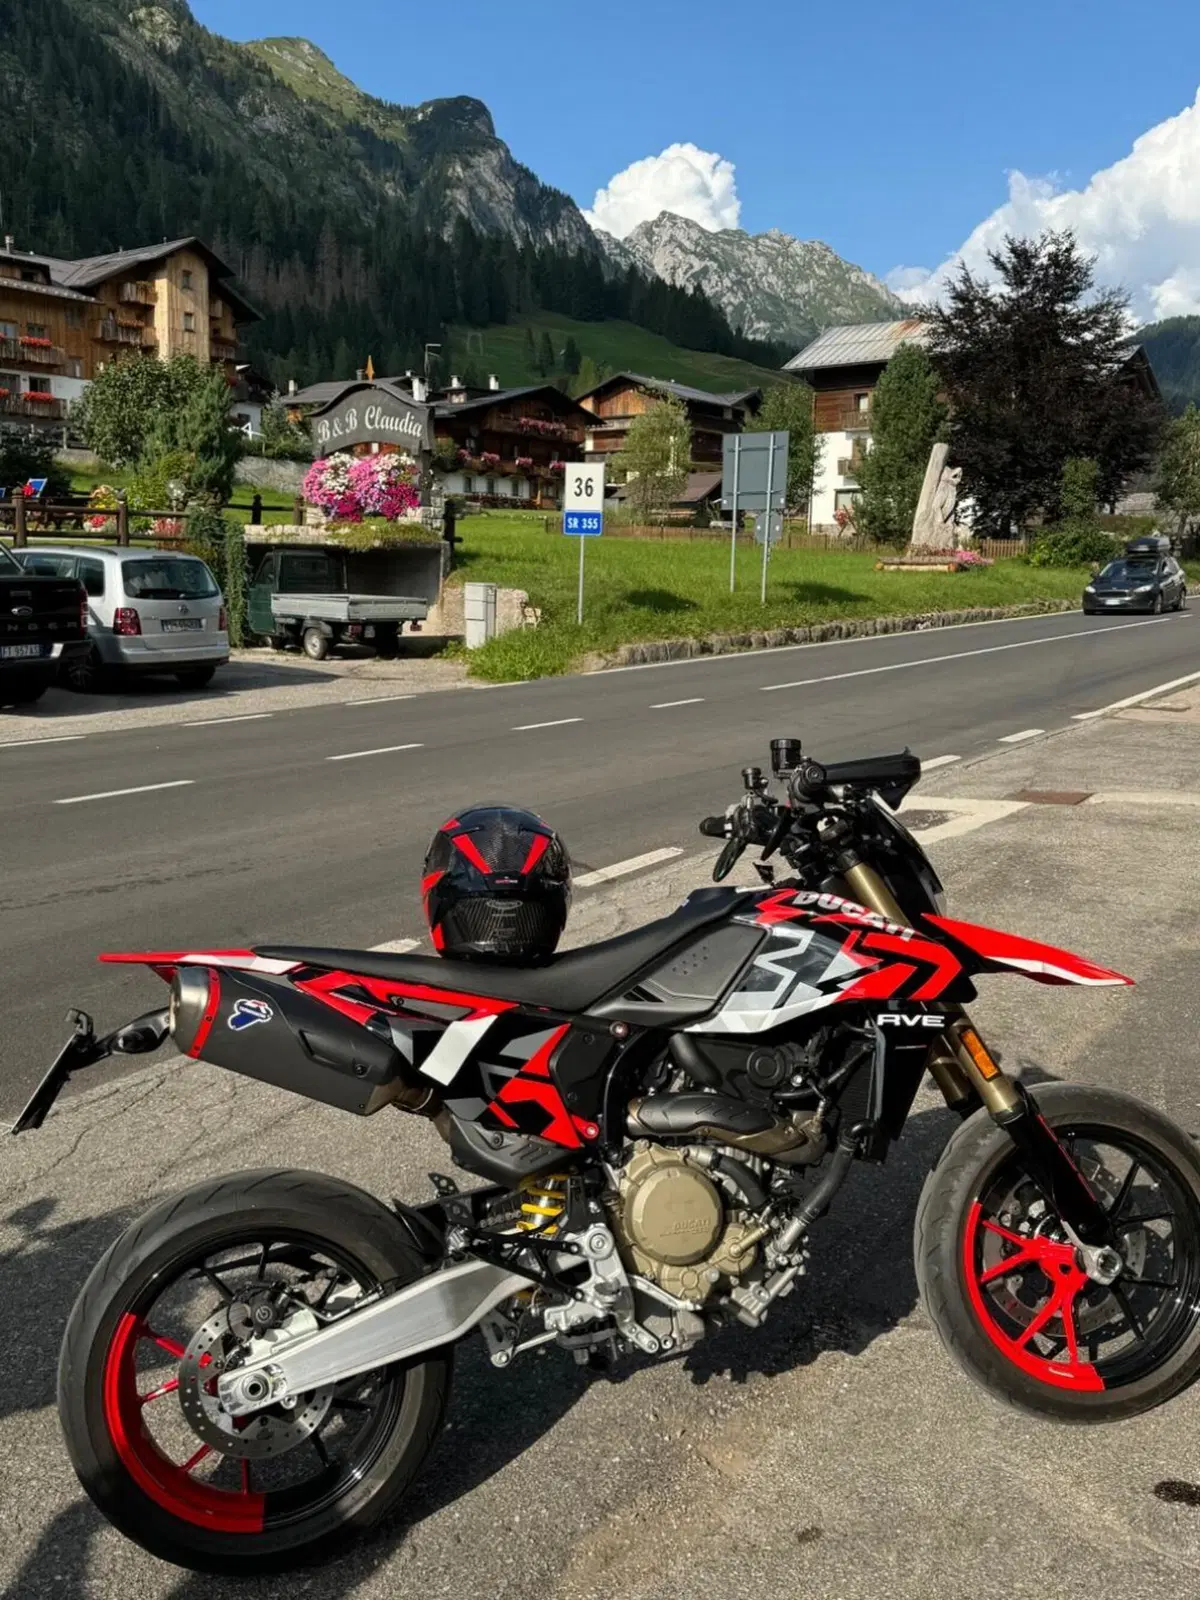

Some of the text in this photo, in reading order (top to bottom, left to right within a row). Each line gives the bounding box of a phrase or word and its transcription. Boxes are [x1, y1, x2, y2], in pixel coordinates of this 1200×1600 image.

[364, 405, 422, 437] Claudia
[574, 476, 594, 497] 36
[567, 517, 598, 530] SR 355
[792, 890, 915, 942] DUCATI
